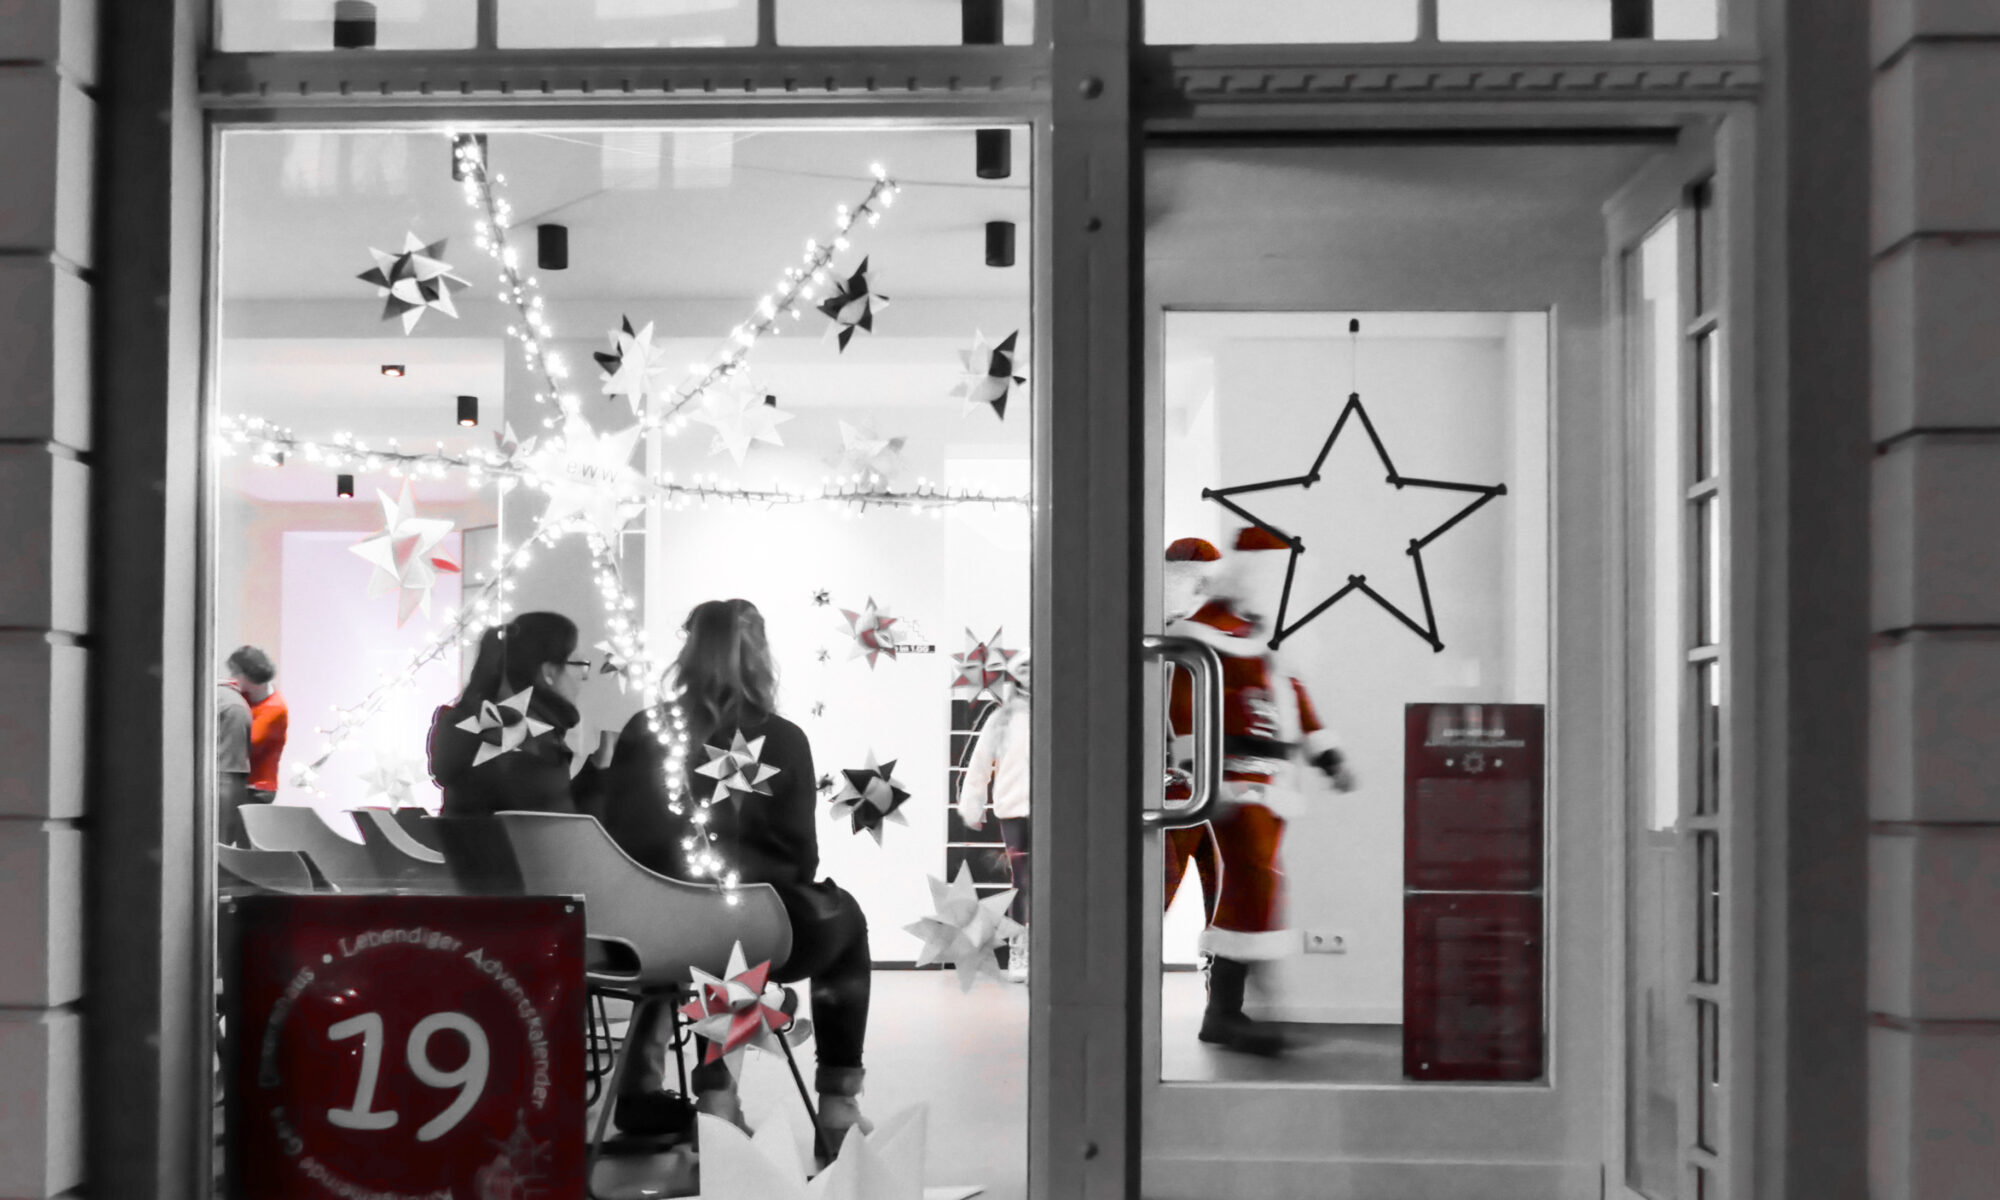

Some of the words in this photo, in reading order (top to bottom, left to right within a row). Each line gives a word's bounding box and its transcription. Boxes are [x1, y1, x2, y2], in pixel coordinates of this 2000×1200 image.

[328, 1012, 490, 1142] 19
[339, 927, 462, 957] Lebendiger
[465, 947, 551, 1109] Adventskalender
